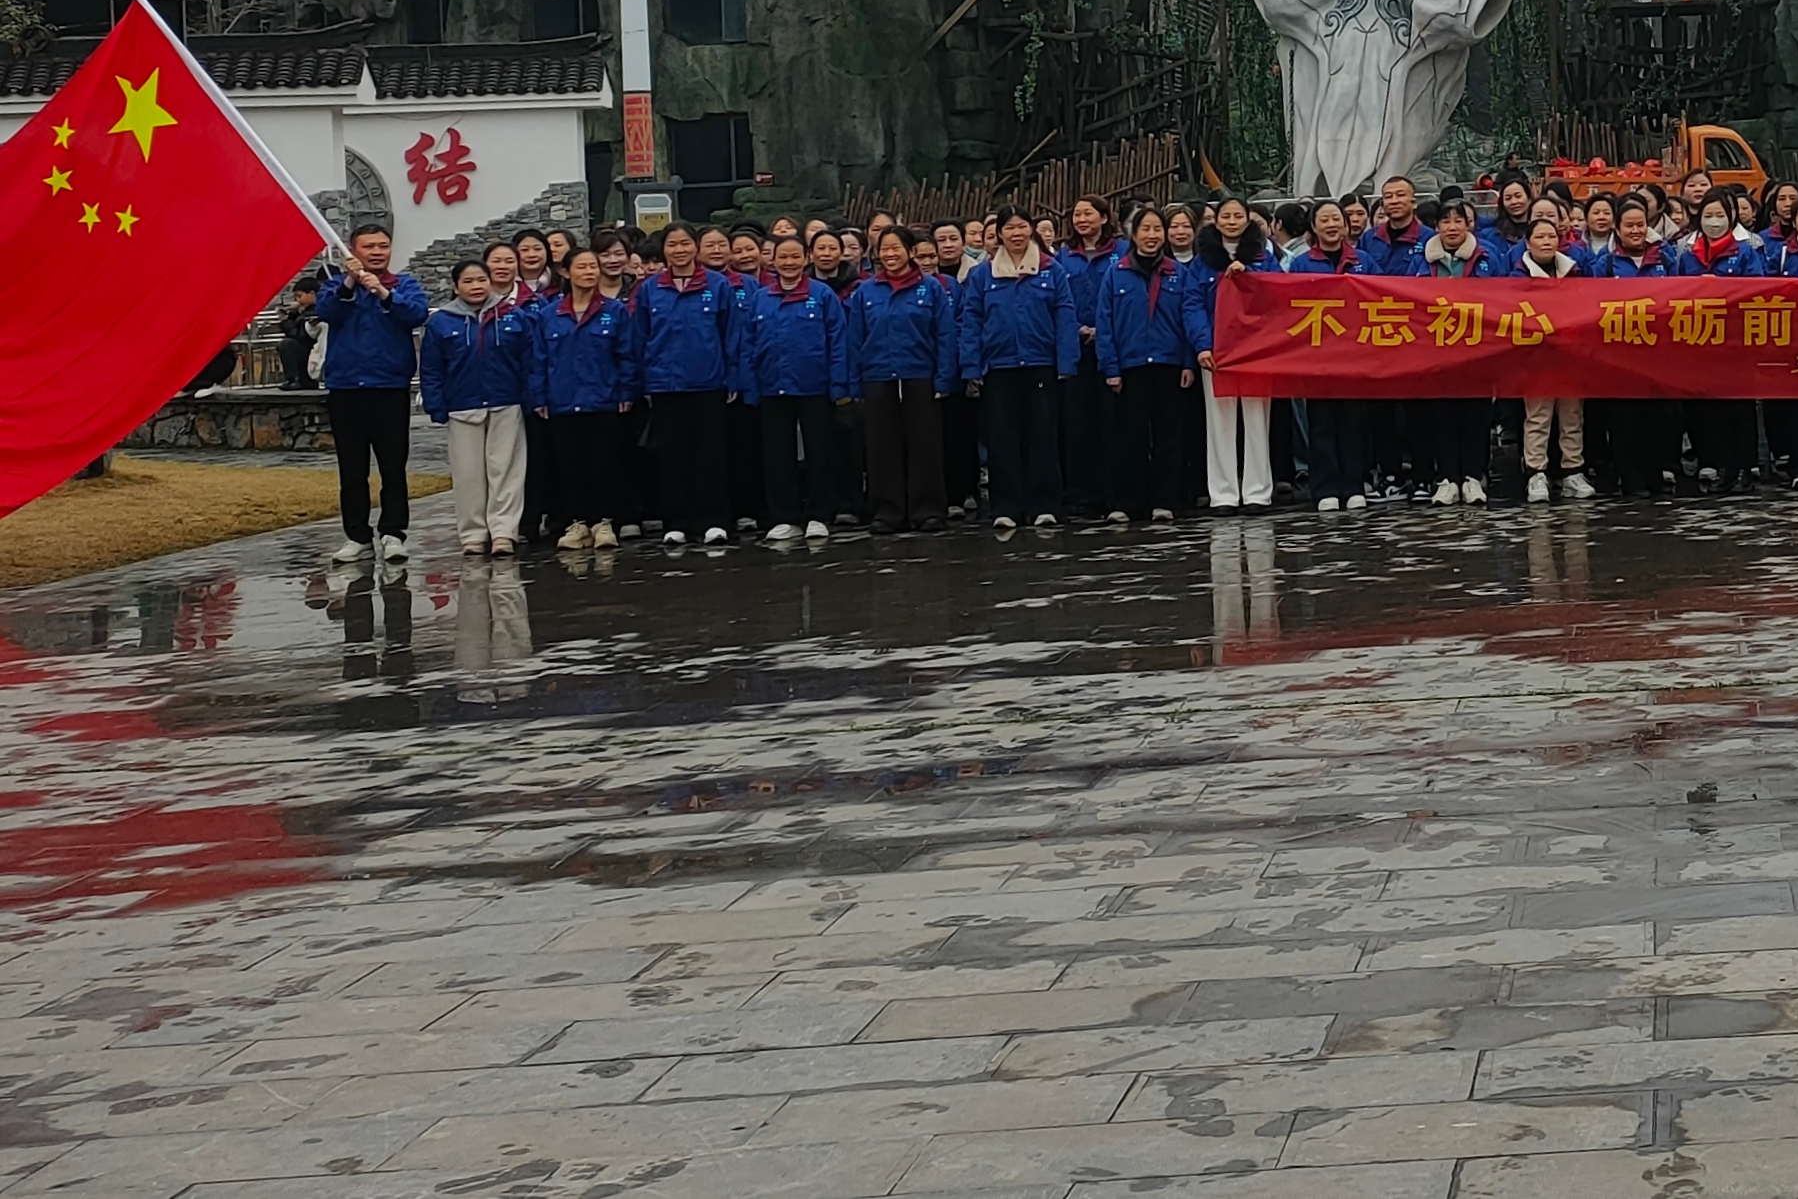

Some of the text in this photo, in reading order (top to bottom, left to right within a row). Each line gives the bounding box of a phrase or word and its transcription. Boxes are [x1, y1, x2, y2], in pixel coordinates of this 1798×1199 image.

[404, 127, 477, 205] 结
[1286, 296, 1555, 347] 不忘初心
